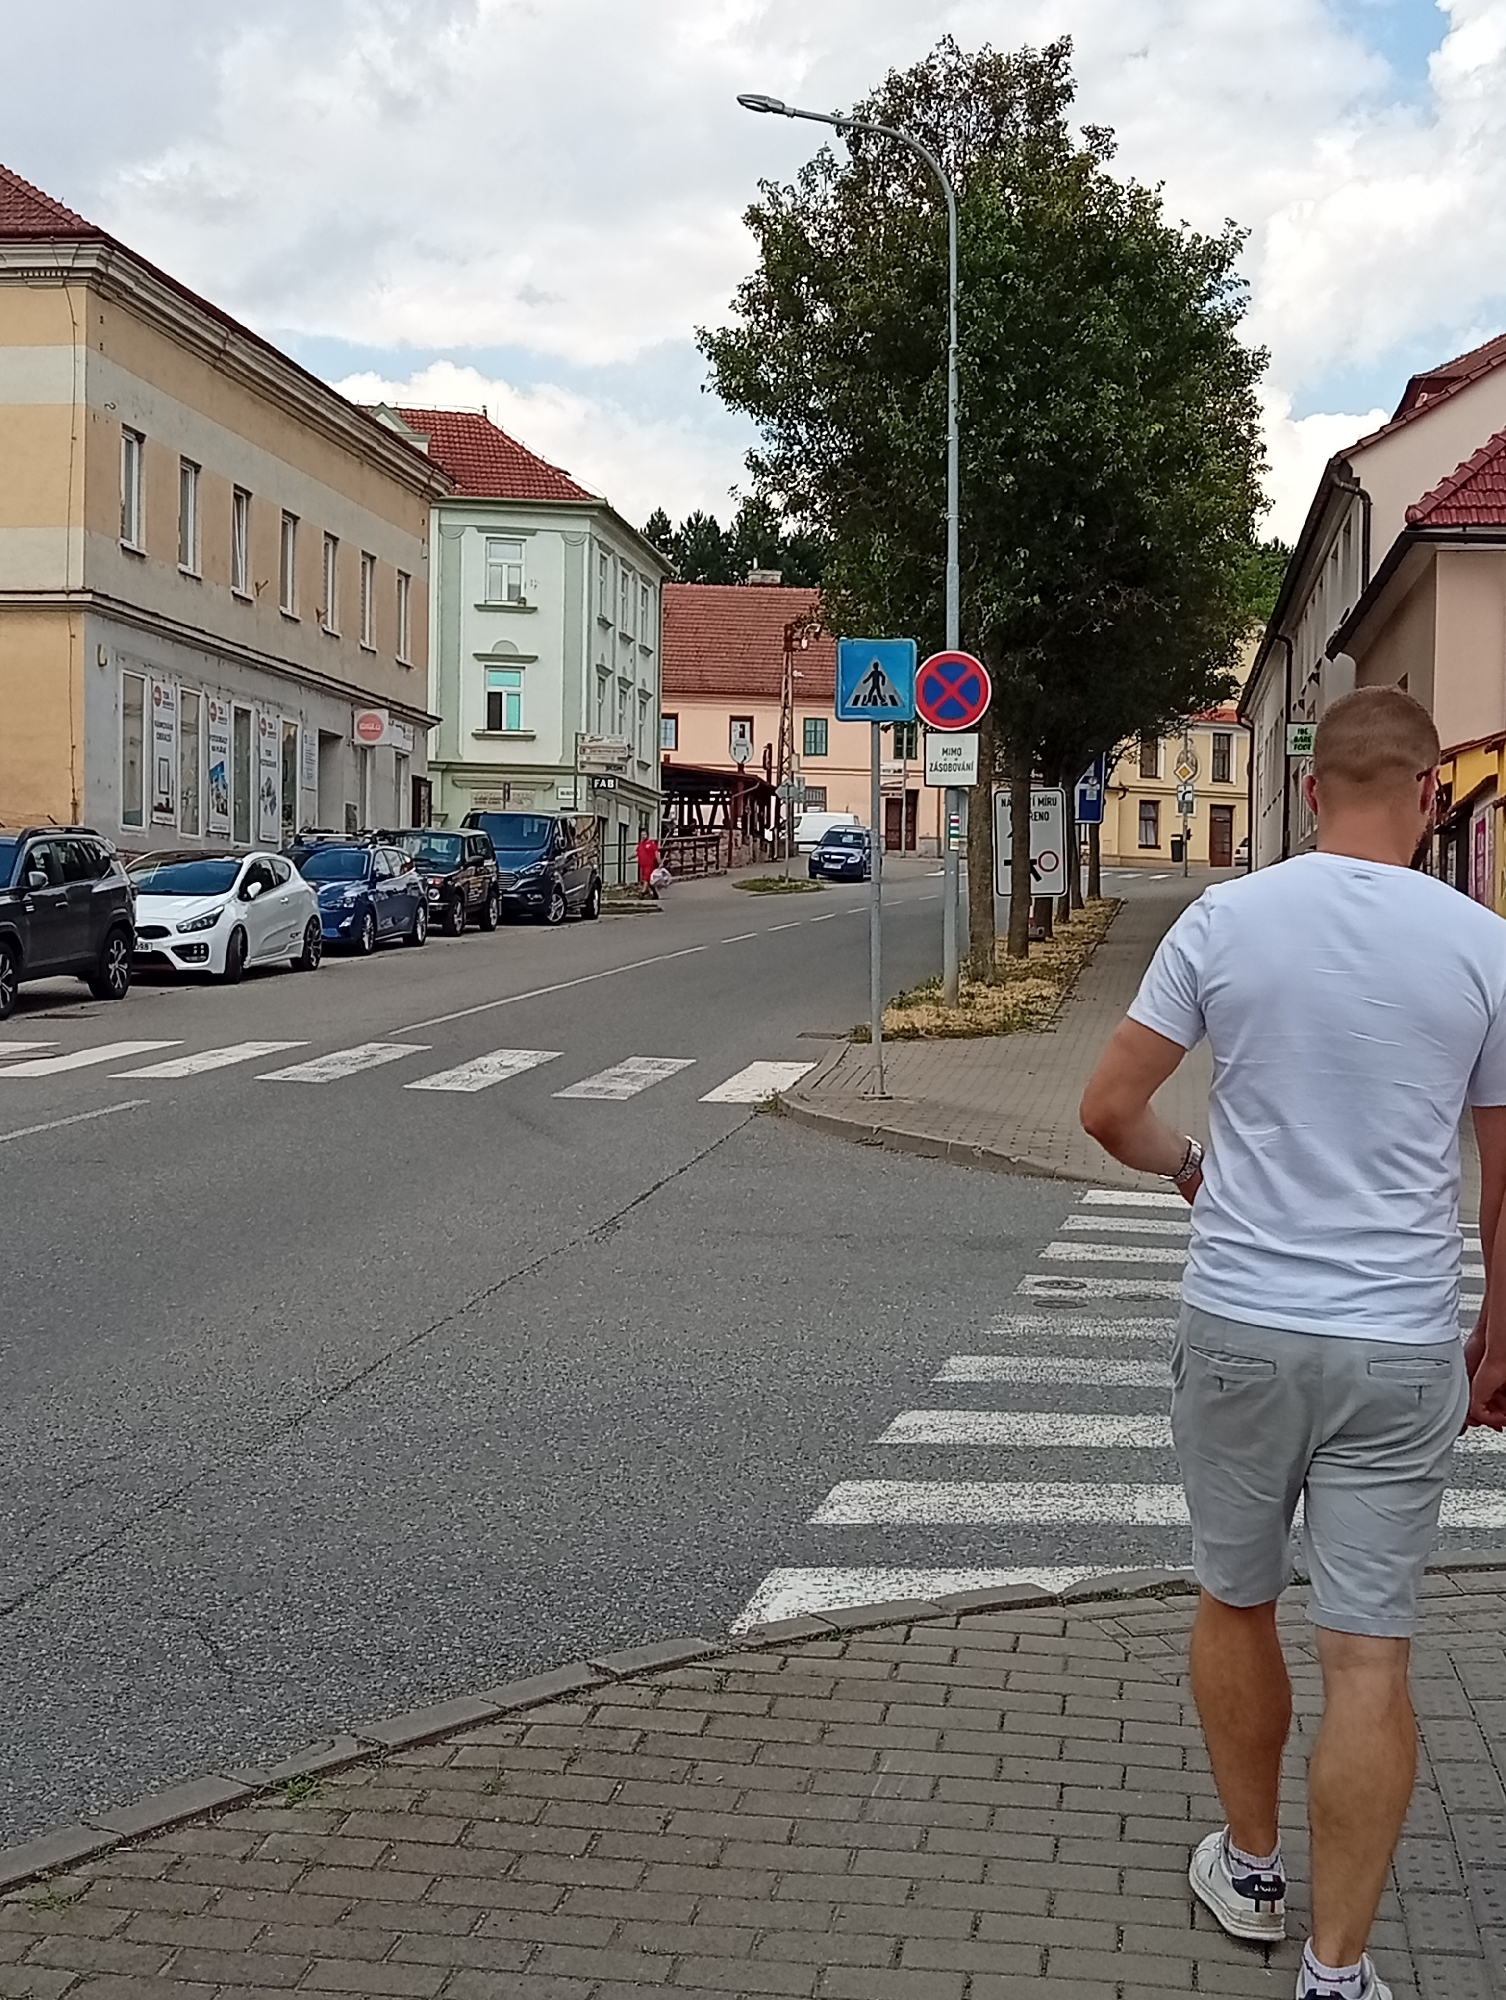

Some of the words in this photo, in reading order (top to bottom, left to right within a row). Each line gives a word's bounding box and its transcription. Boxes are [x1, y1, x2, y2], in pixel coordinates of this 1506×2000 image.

[941, 747, 962, 757] MIMO
[929, 760, 974, 772] ZÁSOBOVÁNÍ
[594, 778, 615, 788] FAB
[1037, 795, 1057, 807] MÍRU
